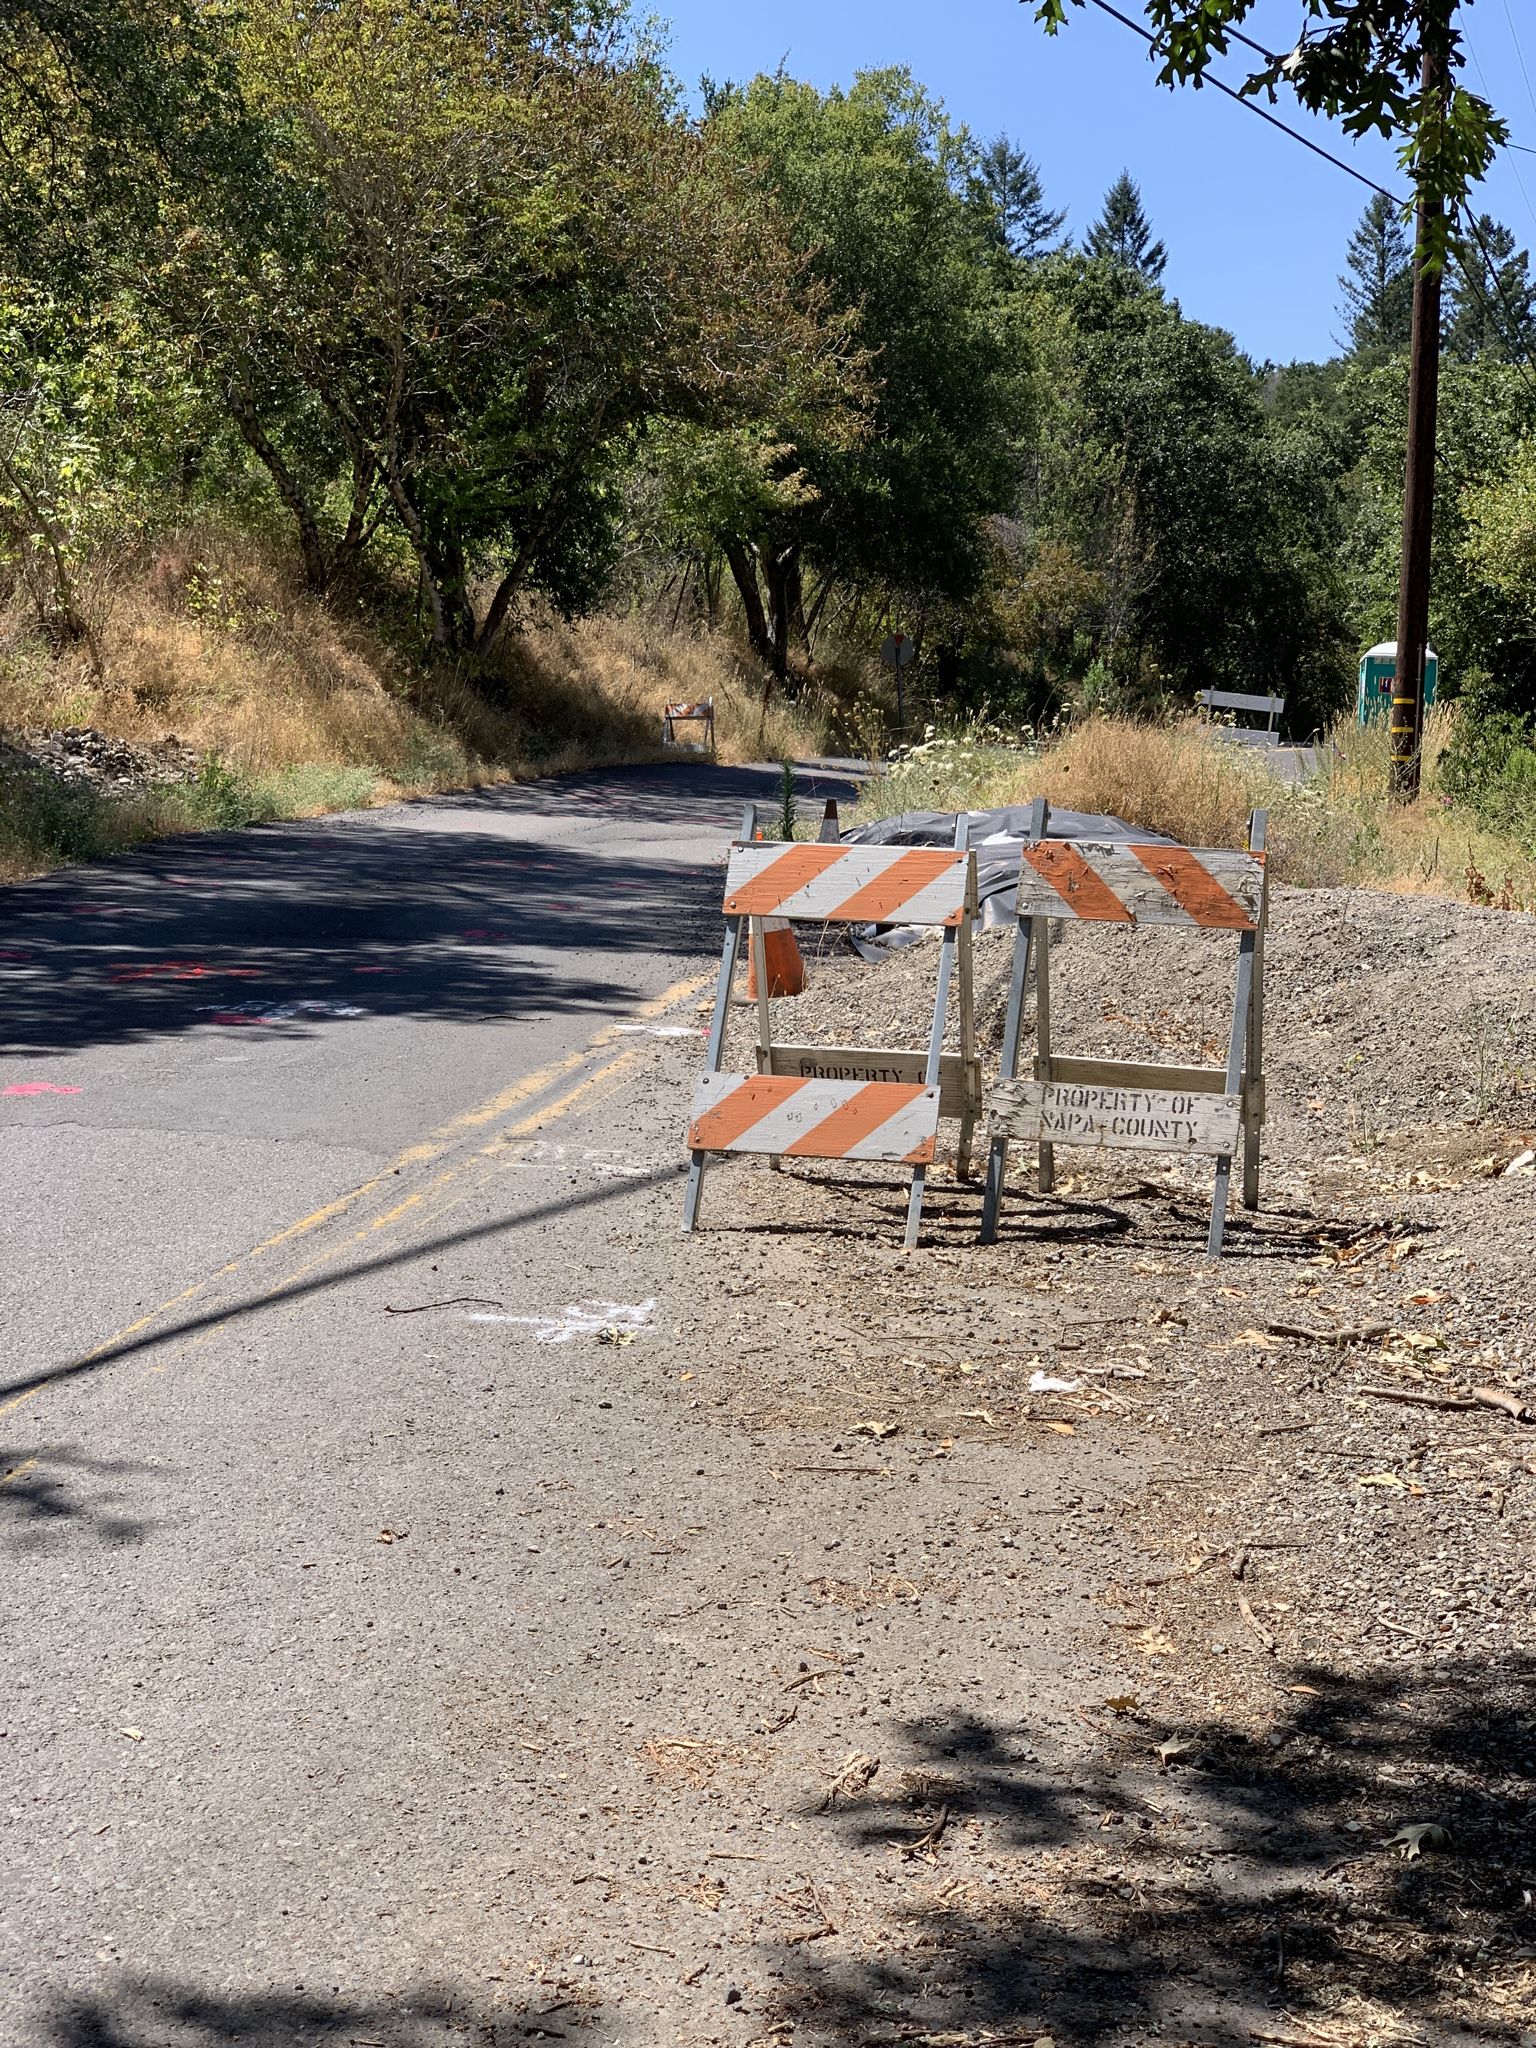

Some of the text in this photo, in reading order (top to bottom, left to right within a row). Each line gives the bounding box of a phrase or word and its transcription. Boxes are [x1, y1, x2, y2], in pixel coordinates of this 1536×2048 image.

[800, 1066, 903, 1083] PROPERTY
[1041, 1086, 1201, 1115] PROPERTY OF
[1040, 1110, 1198, 1139] NAPA COUNTY
